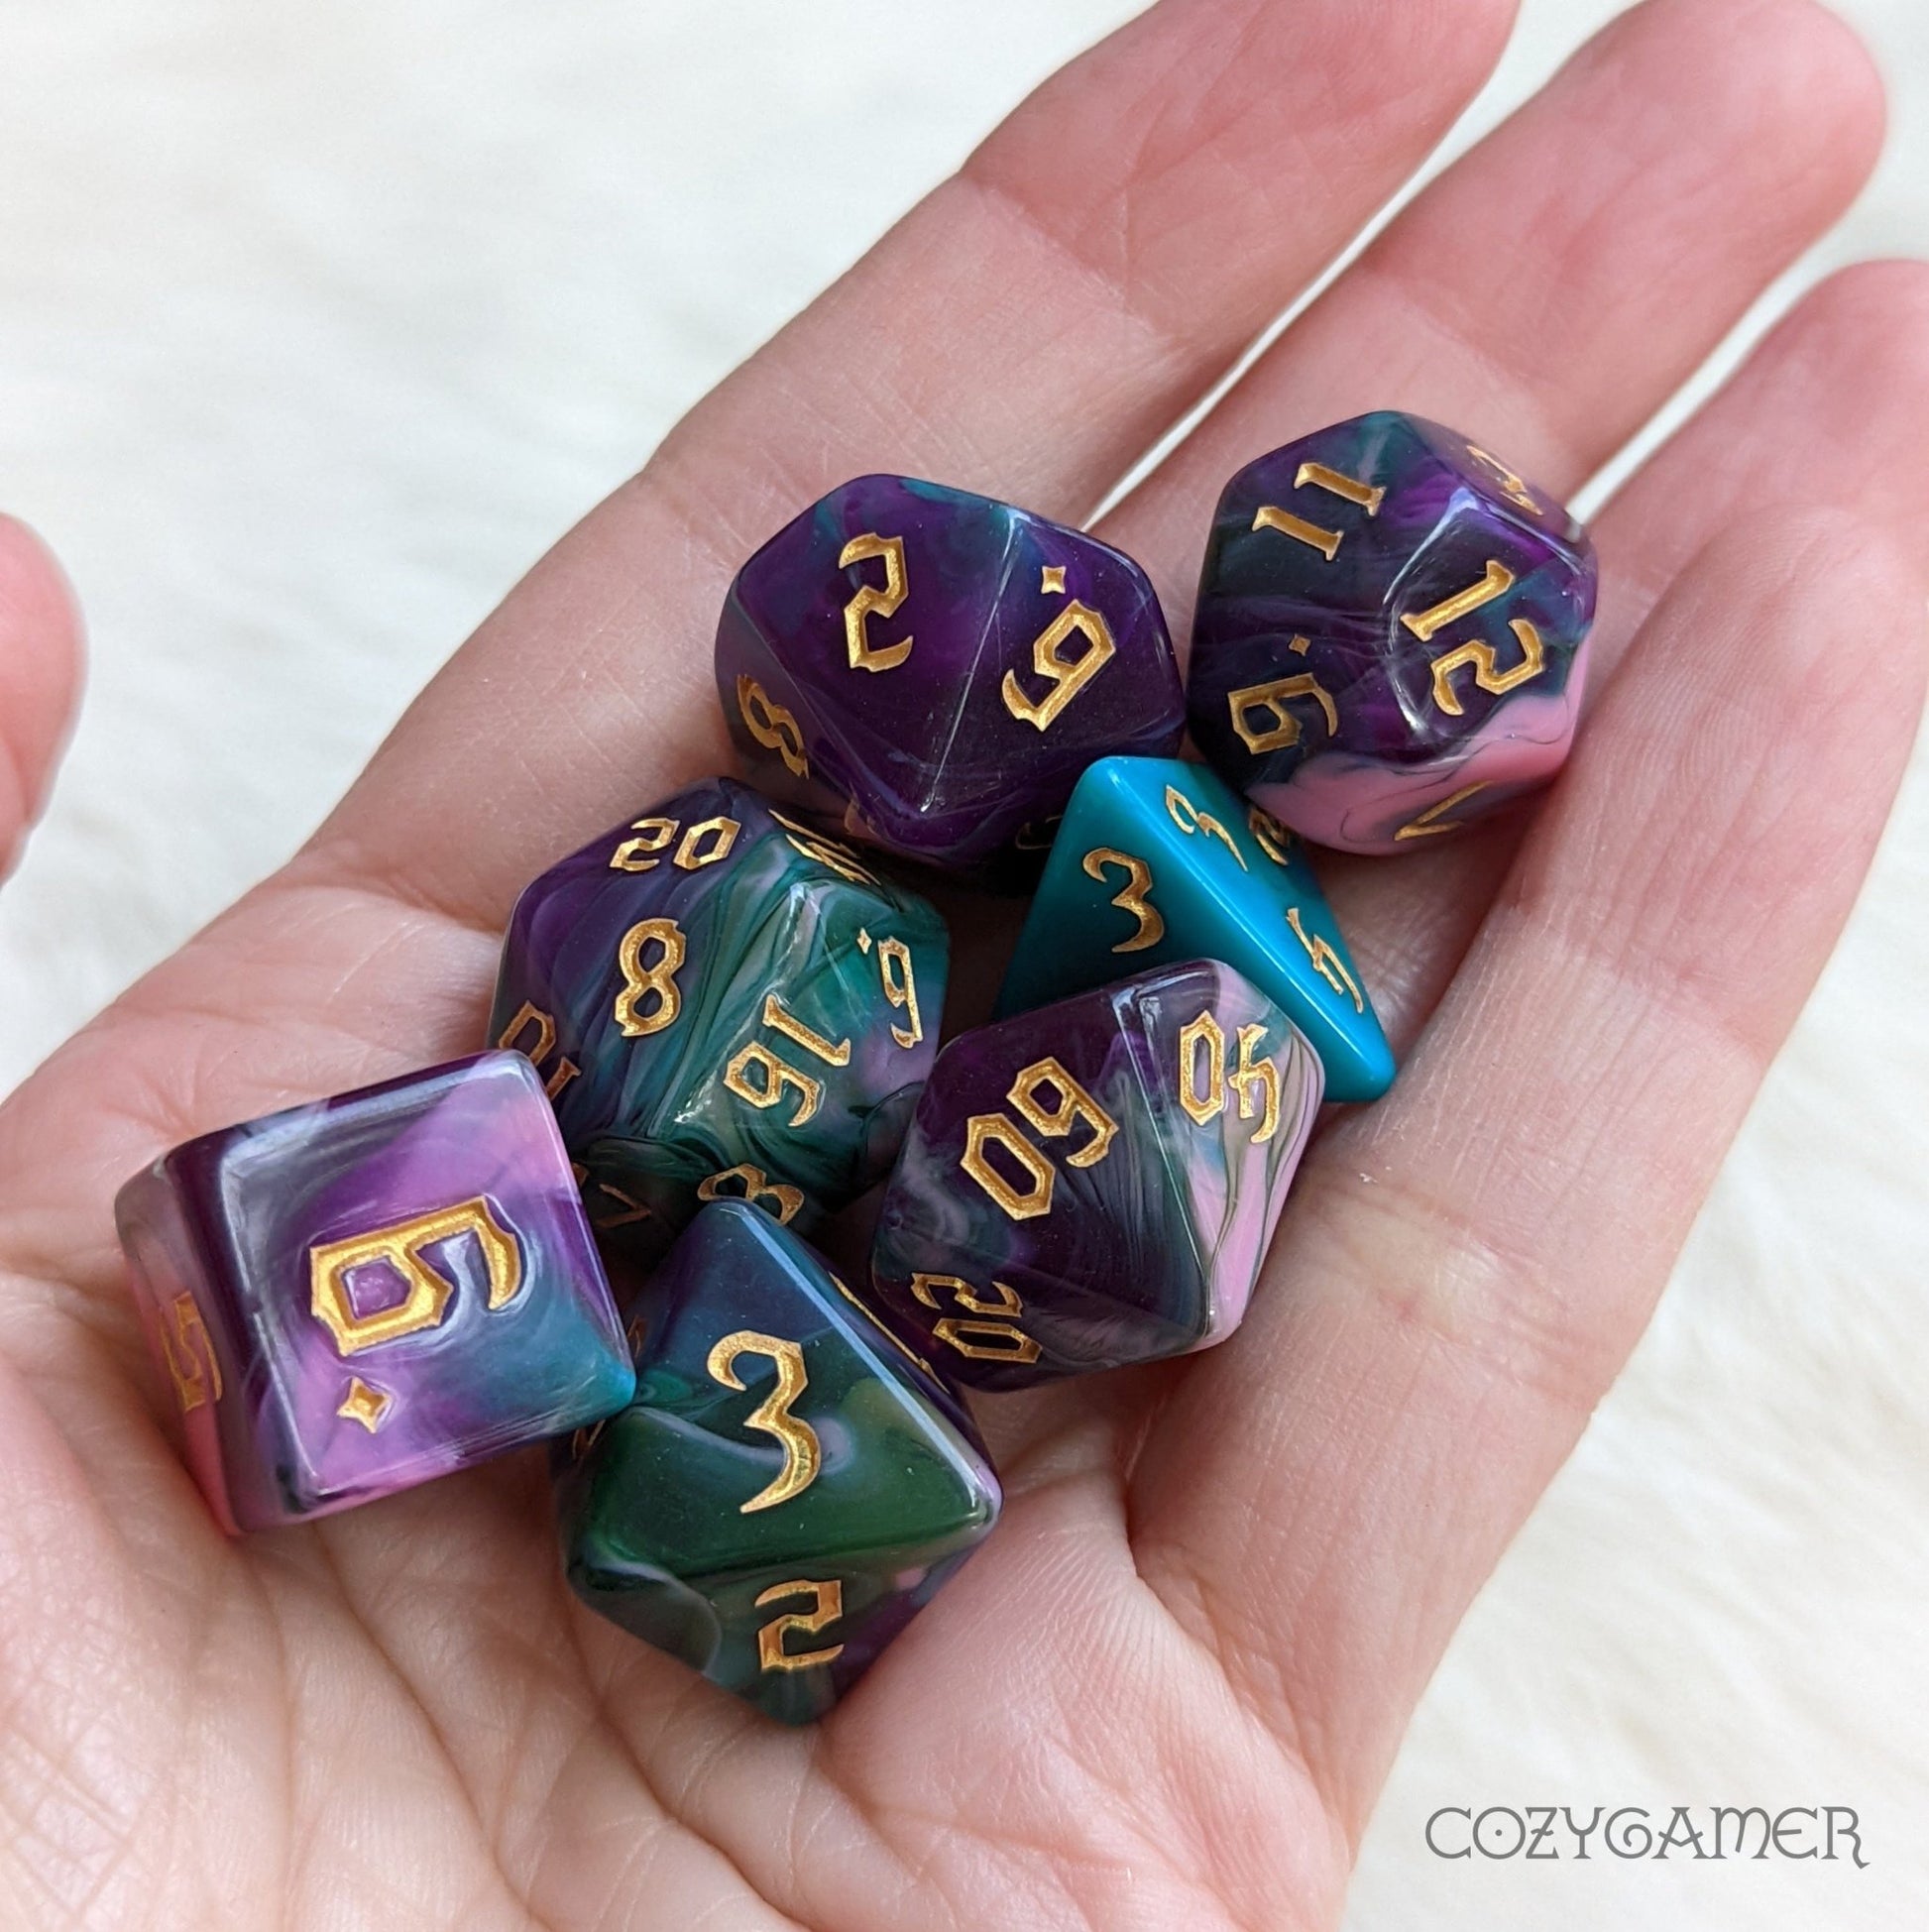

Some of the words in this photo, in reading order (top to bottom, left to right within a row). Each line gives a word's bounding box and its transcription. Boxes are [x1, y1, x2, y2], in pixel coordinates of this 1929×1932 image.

[1251, 463, 1386, 560] 11
[839, 532, 913, 672] 2
[1400, 560, 1543, 716] 12
[610, 816, 741, 871] 20
[1082, 847, 1164, 953] 3
[615, 918, 686, 1037] 8
[1180, 1010, 1280, 1144] 40
[912, 1273, 1043, 1365] 20
[707, 1330, 822, 1514] 3
[755, 1579, 845, 1672] 2
